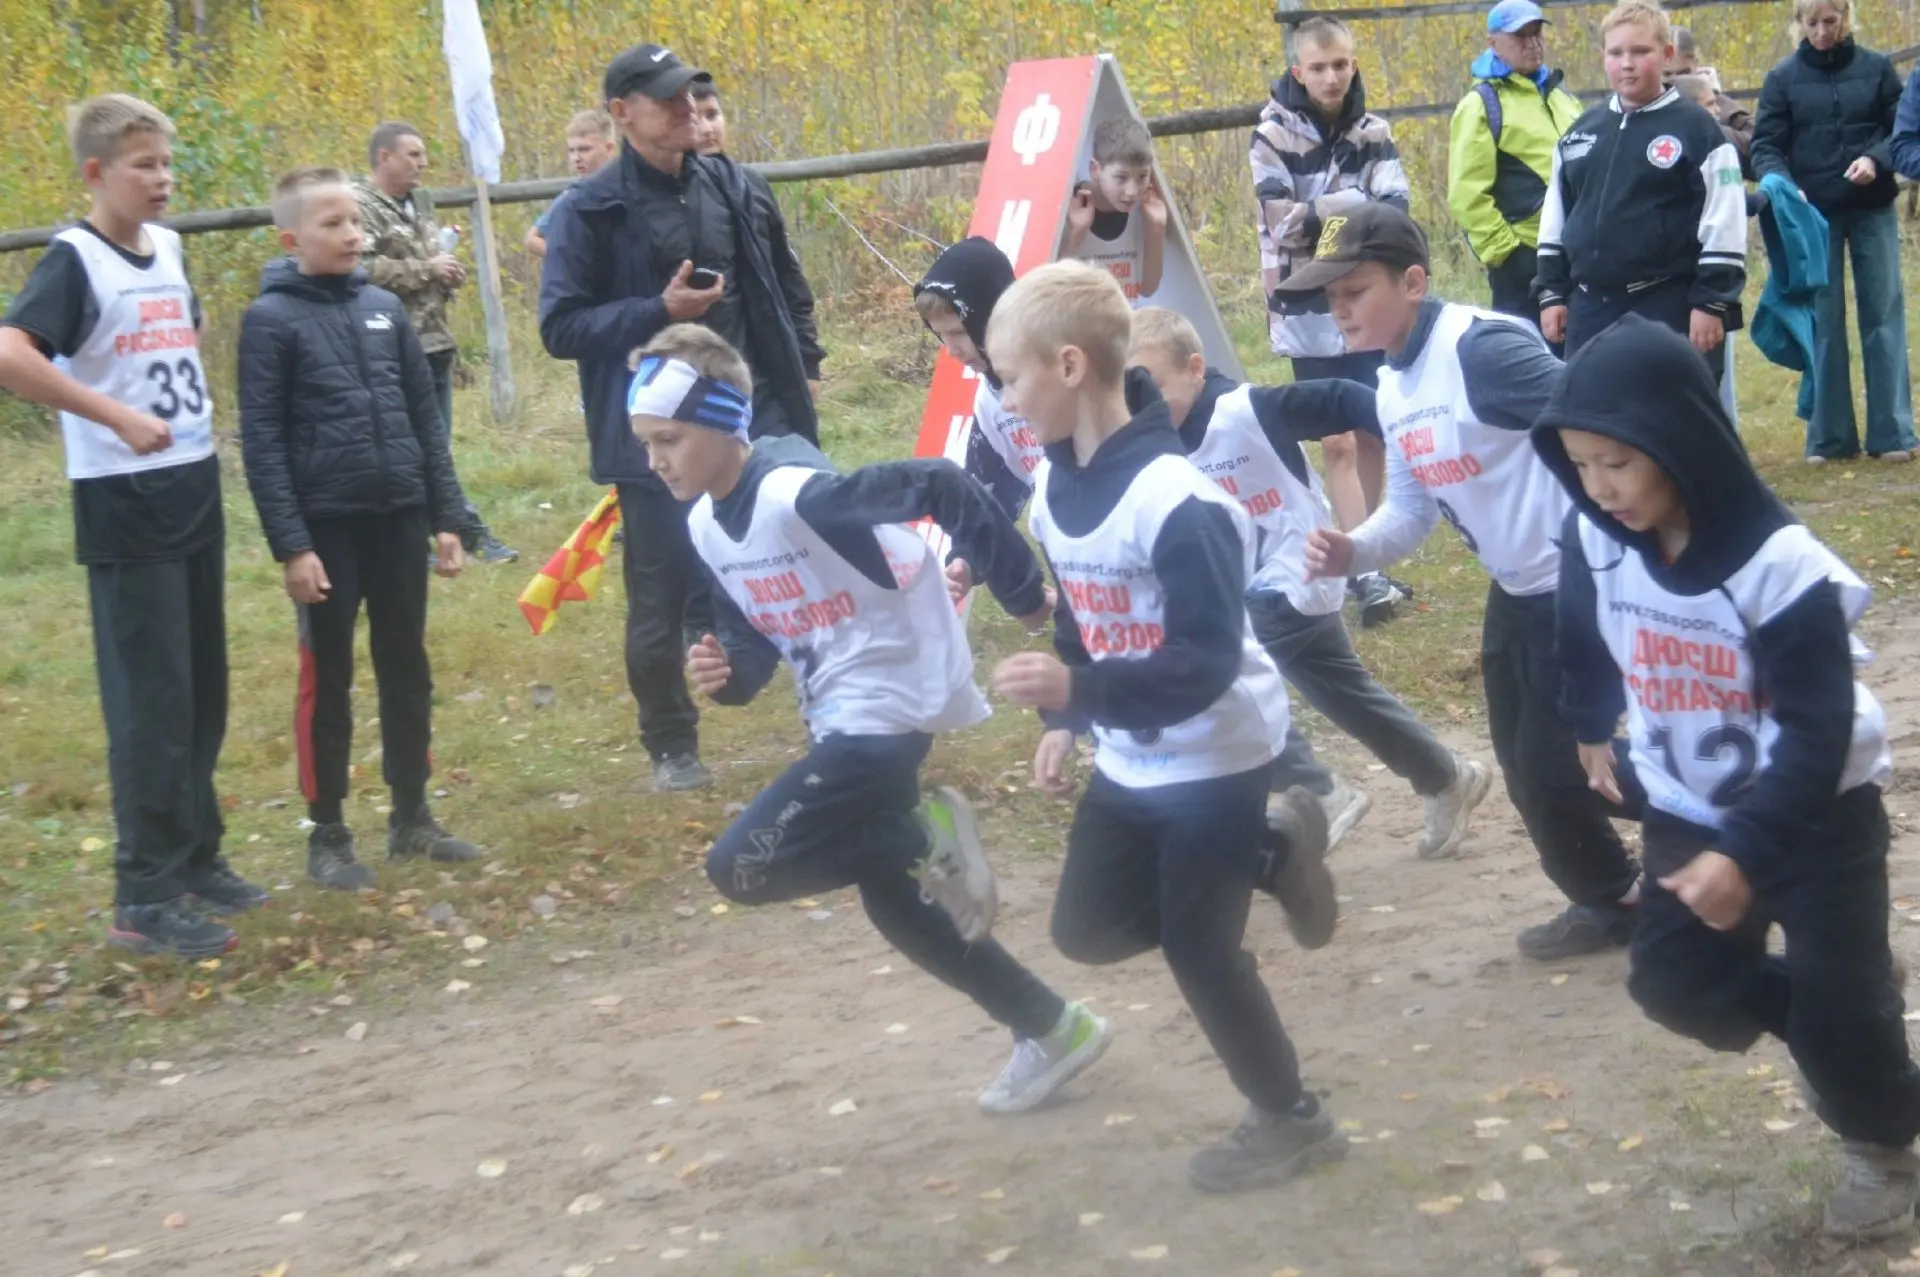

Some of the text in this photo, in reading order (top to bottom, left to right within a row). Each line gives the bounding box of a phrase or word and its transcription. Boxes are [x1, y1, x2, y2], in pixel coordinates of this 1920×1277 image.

[147, 357, 203, 419] 33
[1632, 628, 1738, 680] ДЮСШ
[1645, 722, 1760, 807] 12
